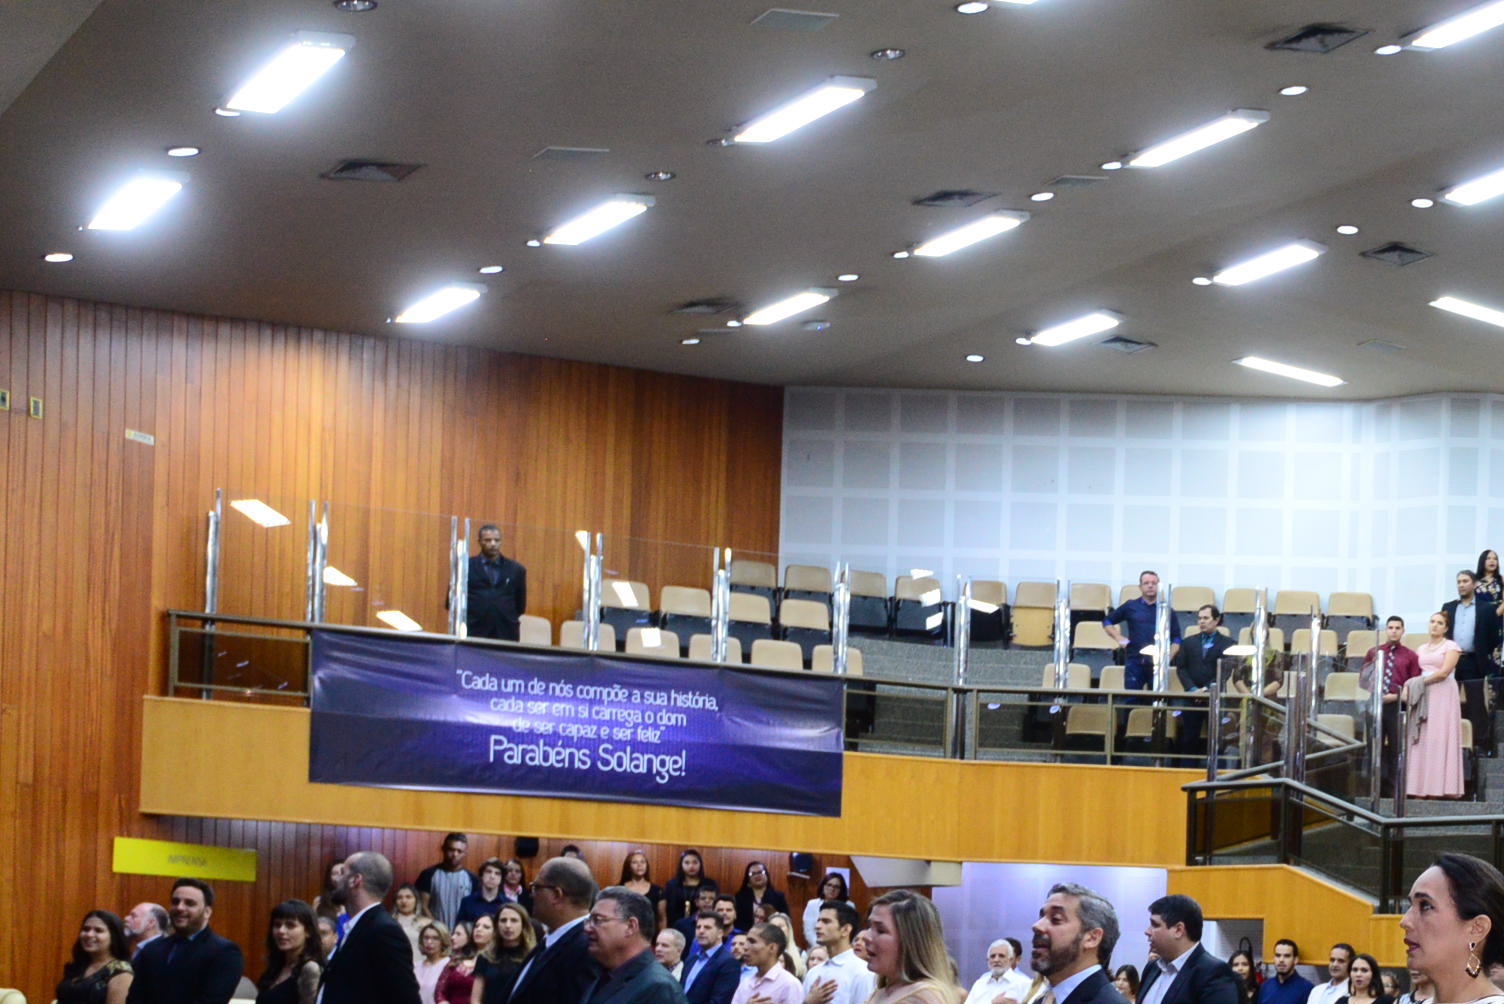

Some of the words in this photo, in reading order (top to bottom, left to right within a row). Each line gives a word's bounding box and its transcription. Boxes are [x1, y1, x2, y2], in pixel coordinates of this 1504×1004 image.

[501, 679, 525, 694] um
[528, 677, 546, 695] de
[549, 680, 574, 698] nós
[576, 684, 629, 706] compõe
[631, 690, 641, 704] a
[643, 690, 668, 706] sua
[670, 689, 719, 711] história,
[490, 696, 524, 713] cada
[527, 701, 550, 715] ser
[552, 703, 575, 718] em
[577, 703, 590, 719] si
[592, 705, 643, 727] carrega
[644, 711, 655, 724] o
[656, 709, 687, 727] dom
[512, 716, 531, 733] de
[533, 721, 556, 735] ser
[559, 722, 598, 742] capaz
[600, 726, 610, 740] e
[612, 727, 634, 742] ser
[489, 734, 592, 770] Parabéns
[597, 743, 687, 784] Solange!
